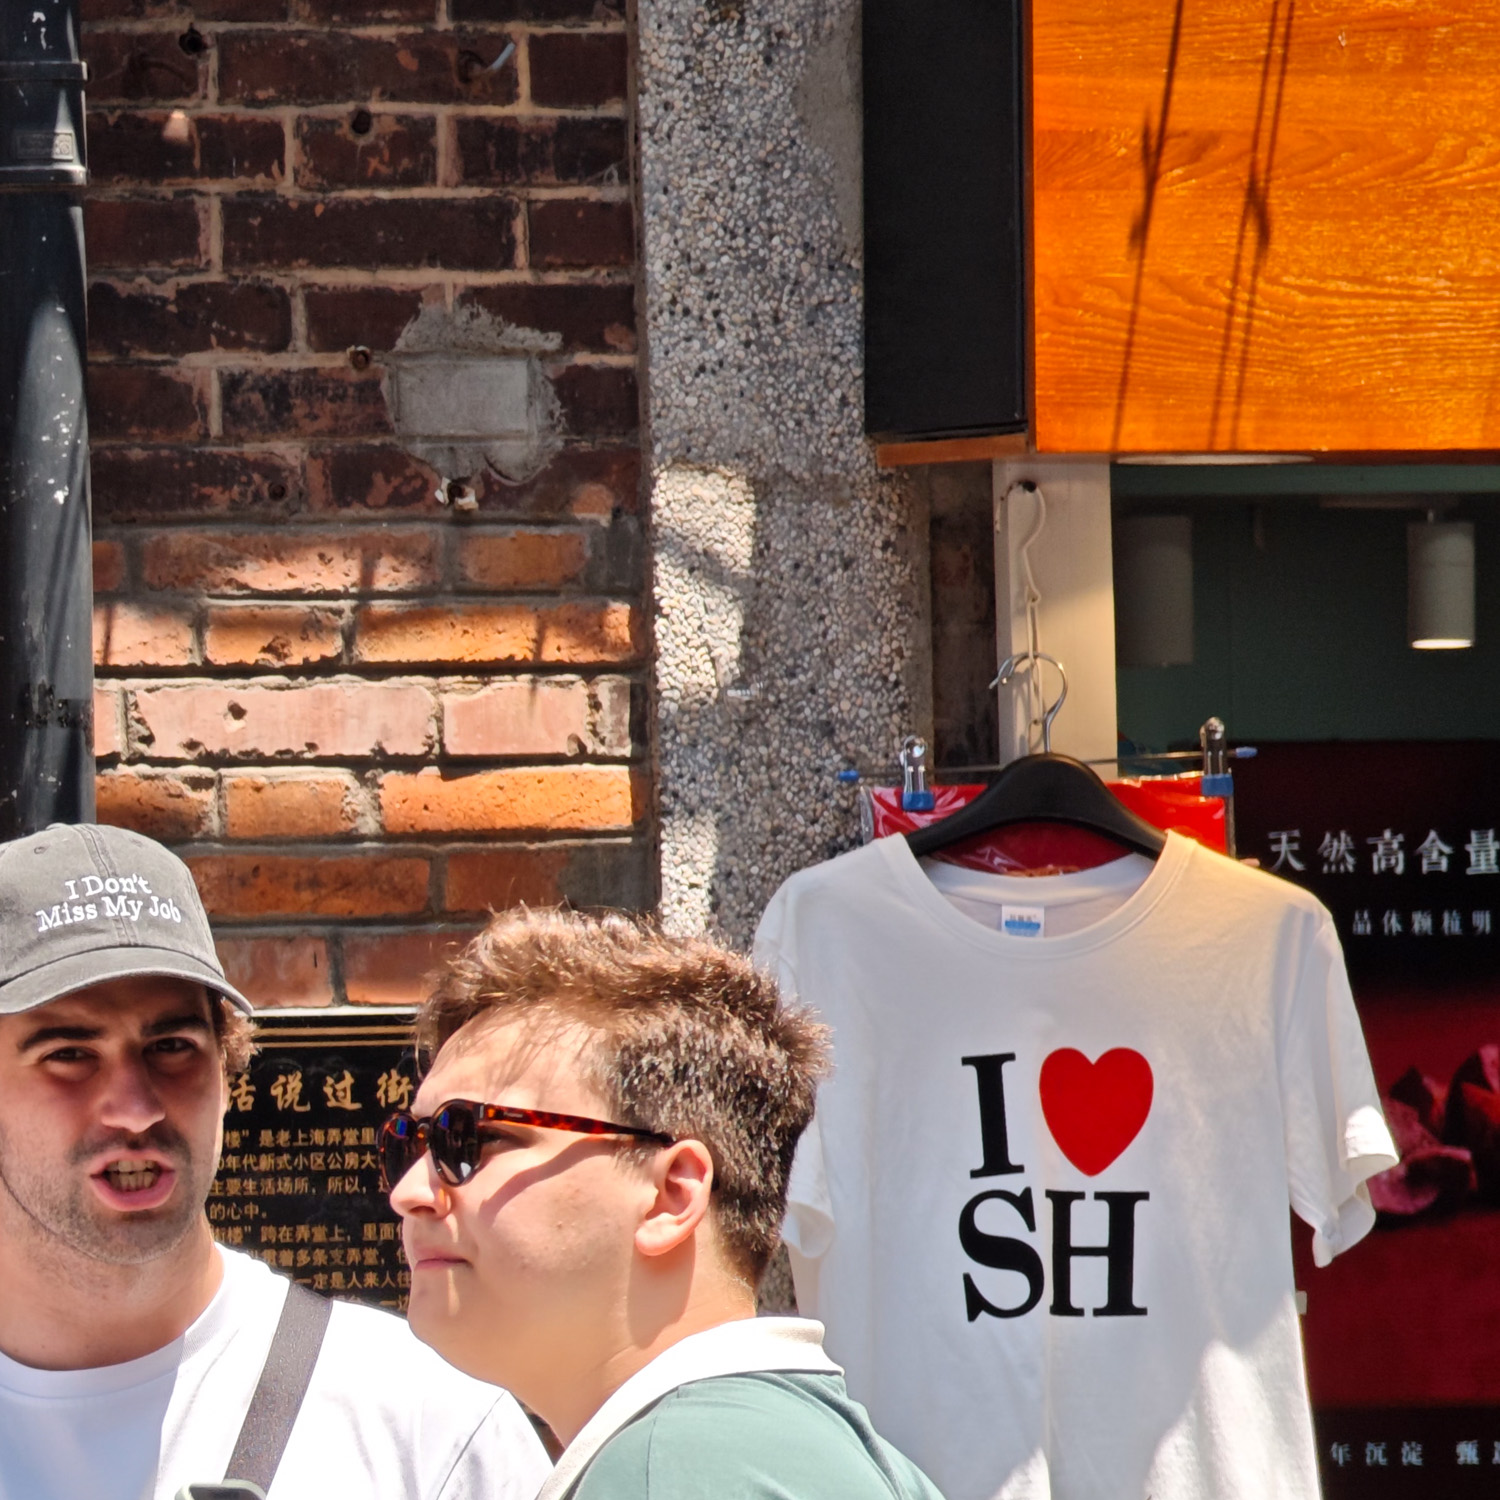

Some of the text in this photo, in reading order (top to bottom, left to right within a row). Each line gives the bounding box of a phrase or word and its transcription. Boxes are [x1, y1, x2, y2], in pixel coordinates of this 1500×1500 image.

[35, 895, 182, 932] Miss My Job
[64, 873, 153, 900] I Don't
[961, 1052, 1024, 1179] I
[958, 1187, 1150, 1322] SH
